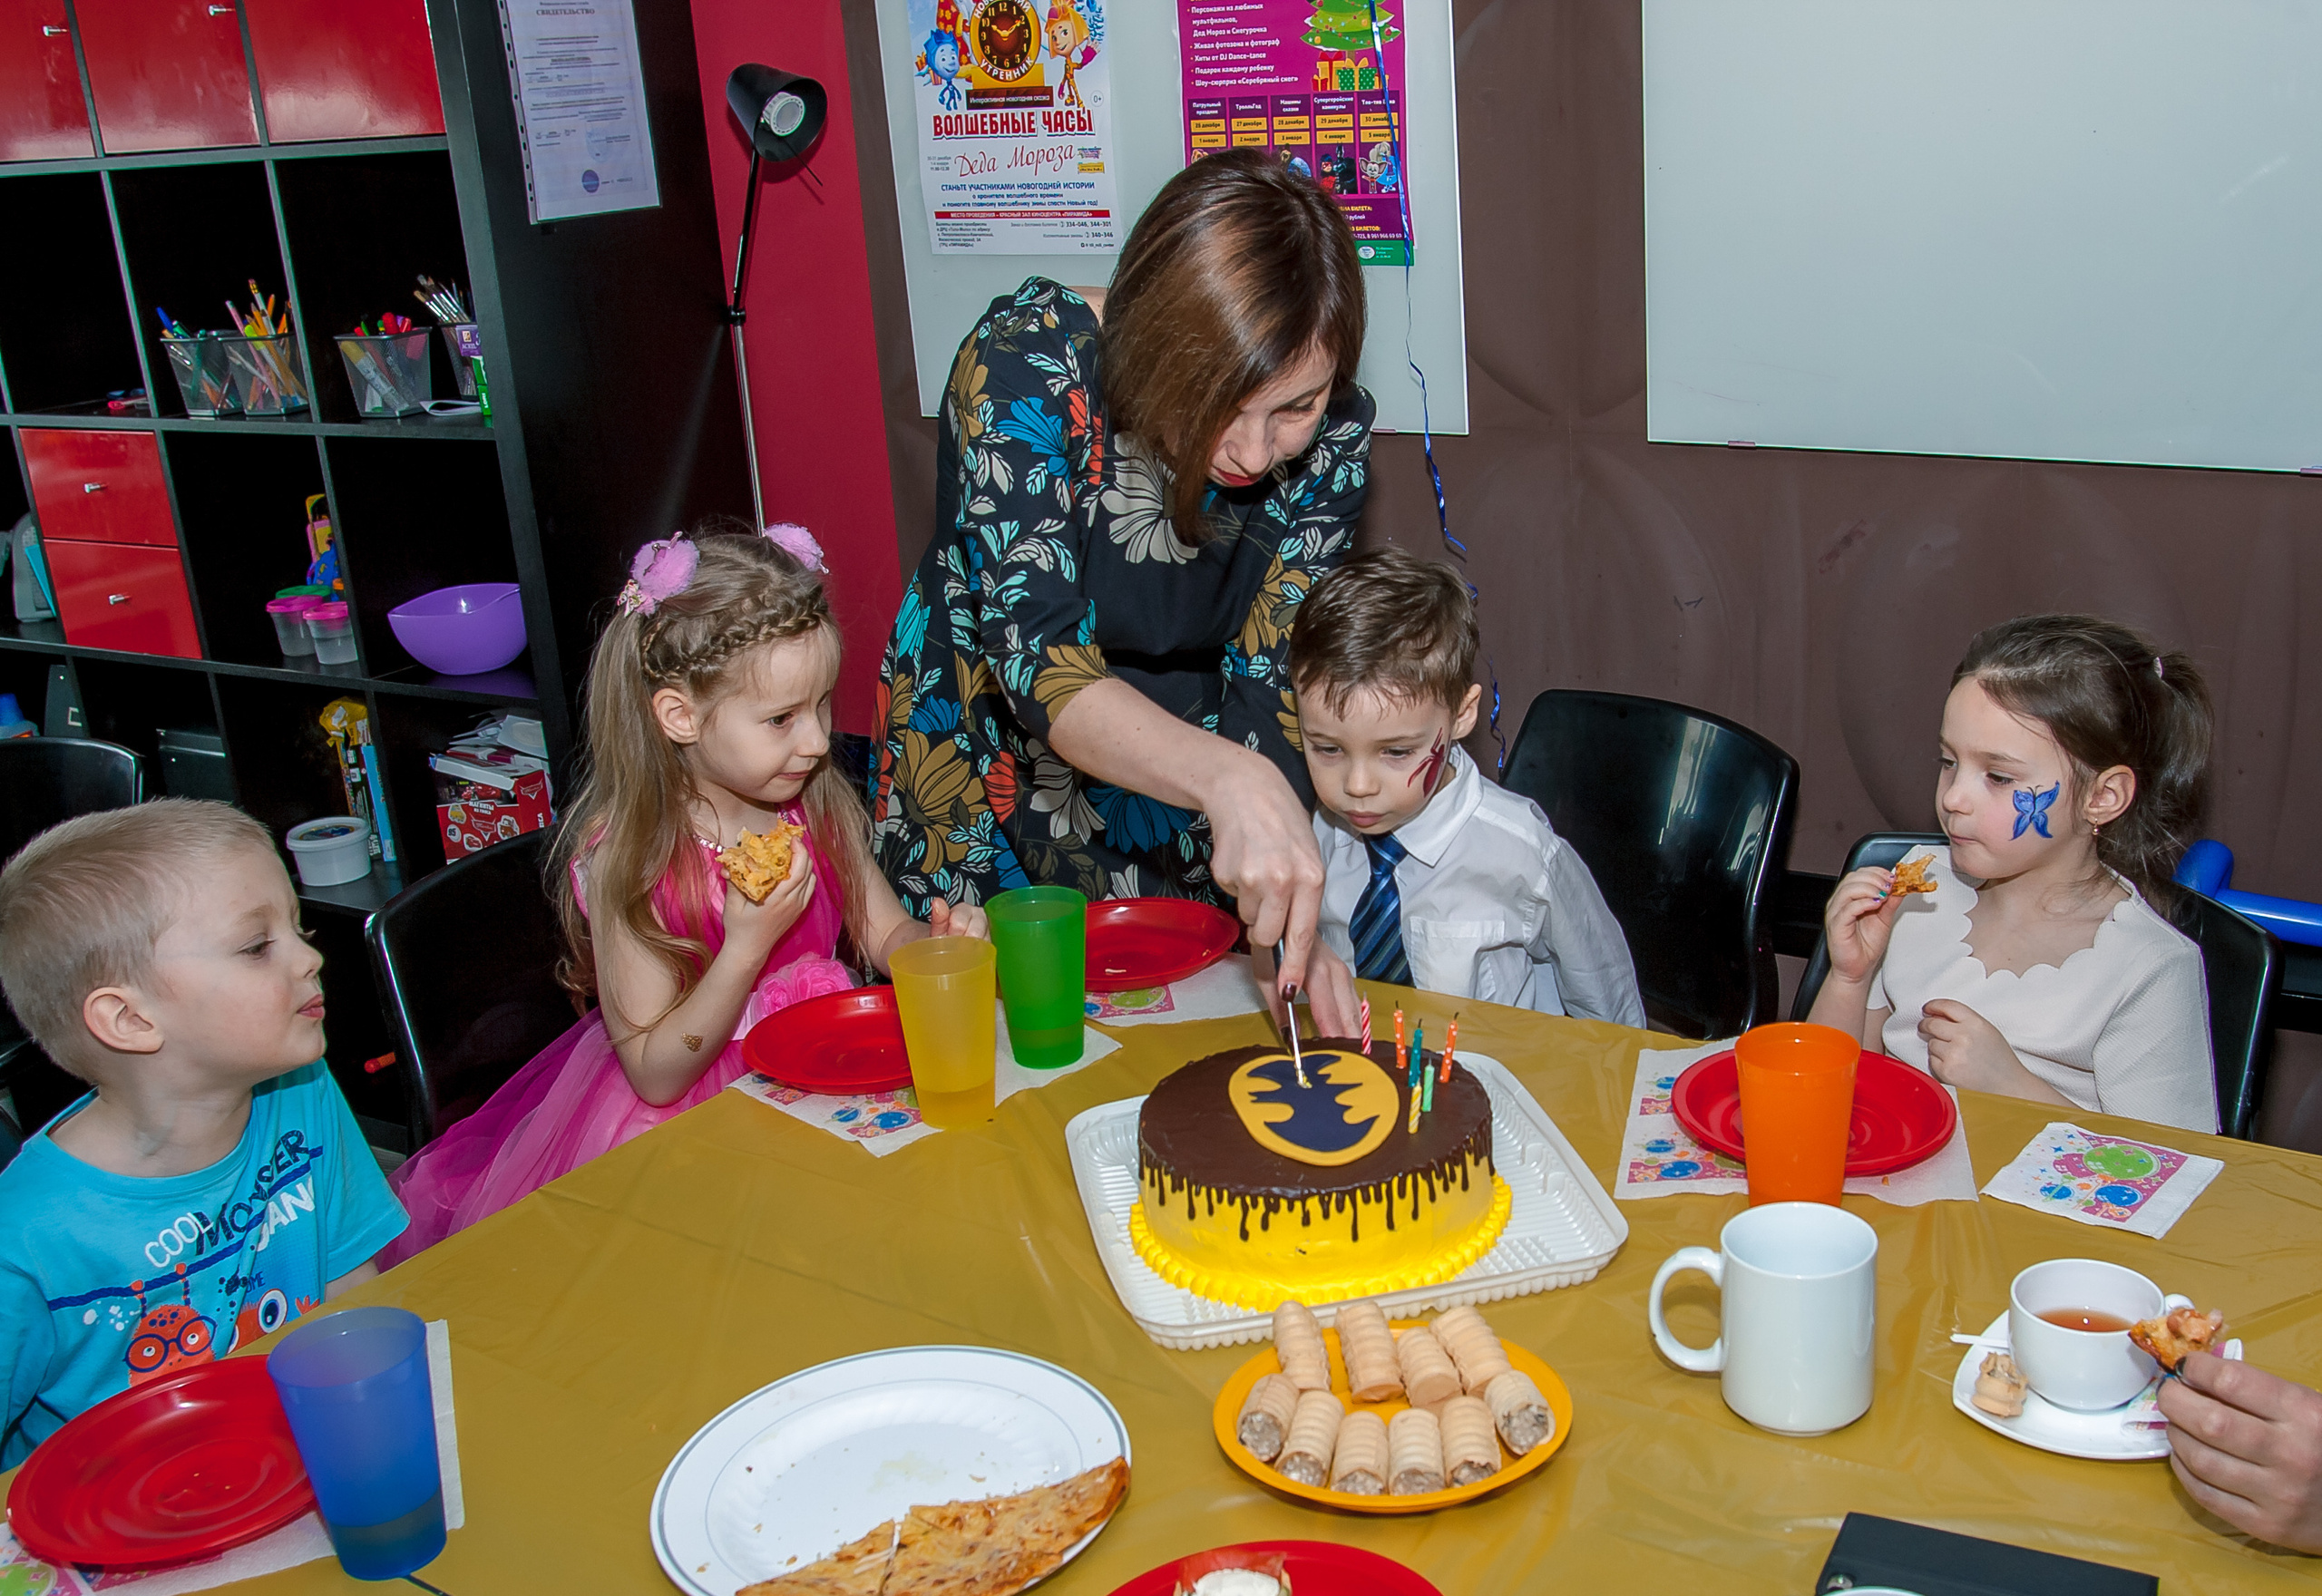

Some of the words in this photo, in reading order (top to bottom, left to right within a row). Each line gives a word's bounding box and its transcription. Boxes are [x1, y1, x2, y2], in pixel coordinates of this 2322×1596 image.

[988, 7, 995, 16] 11
[999, 2, 1008, 12] 12
[1012, 5, 1017, 15] 1
[1191, 6, 1225, 15] Персонажи
[1234, 3, 1263, 11] любимых
[981, 17, 990, 27] 10
[1192, 16, 1238, 26] мультфильмов,
[981, 32, 987, 41] 9
[1023, 29, 1029, 38] 3
[1193, 29, 1206, 37] Дед
[1206, 28, 1225, 37] Мороз
[1231, 26, 1267, 35] Снегурочка
[1215, 40, 1244, 50] фотозона
[1250, 37, 1280, 48] фотограф
[992, 55, 997, 64] 7
[1003, 58, 1010, 68] 6
[981, 56, 1033, 80] УТРЕННИК
[1195, 79, 1237, 87] Шоу-сюрприз
[1237, 75, 1280, 85] «Серебряный
[1093, 95, 1102, 103] 0+
[1313, 95, 1353, 104] Супергеройские
[932, 111, 1037, 136] ВОЛШЕБНЫЕ
[1041, 109, 1094, 133] ЧАСЫ
[954, 151, 999, 177] Деда
[1007, 144, 1076, 177] Мороза
[968, 183, 1016, 191] УЧАСТНИКАМИ
[1017, 181, 1061, 190] НОВОГОДНЕЙ
[1063, 181, 1095, 190] ИСТОРИИ
[468, 801, 494, 812] МАГНИТЫ
[448, 827, 456, 837] 95
[144, 1212, 214, 1268] COOL
[192, 1129, 309, 1257] MONSER
